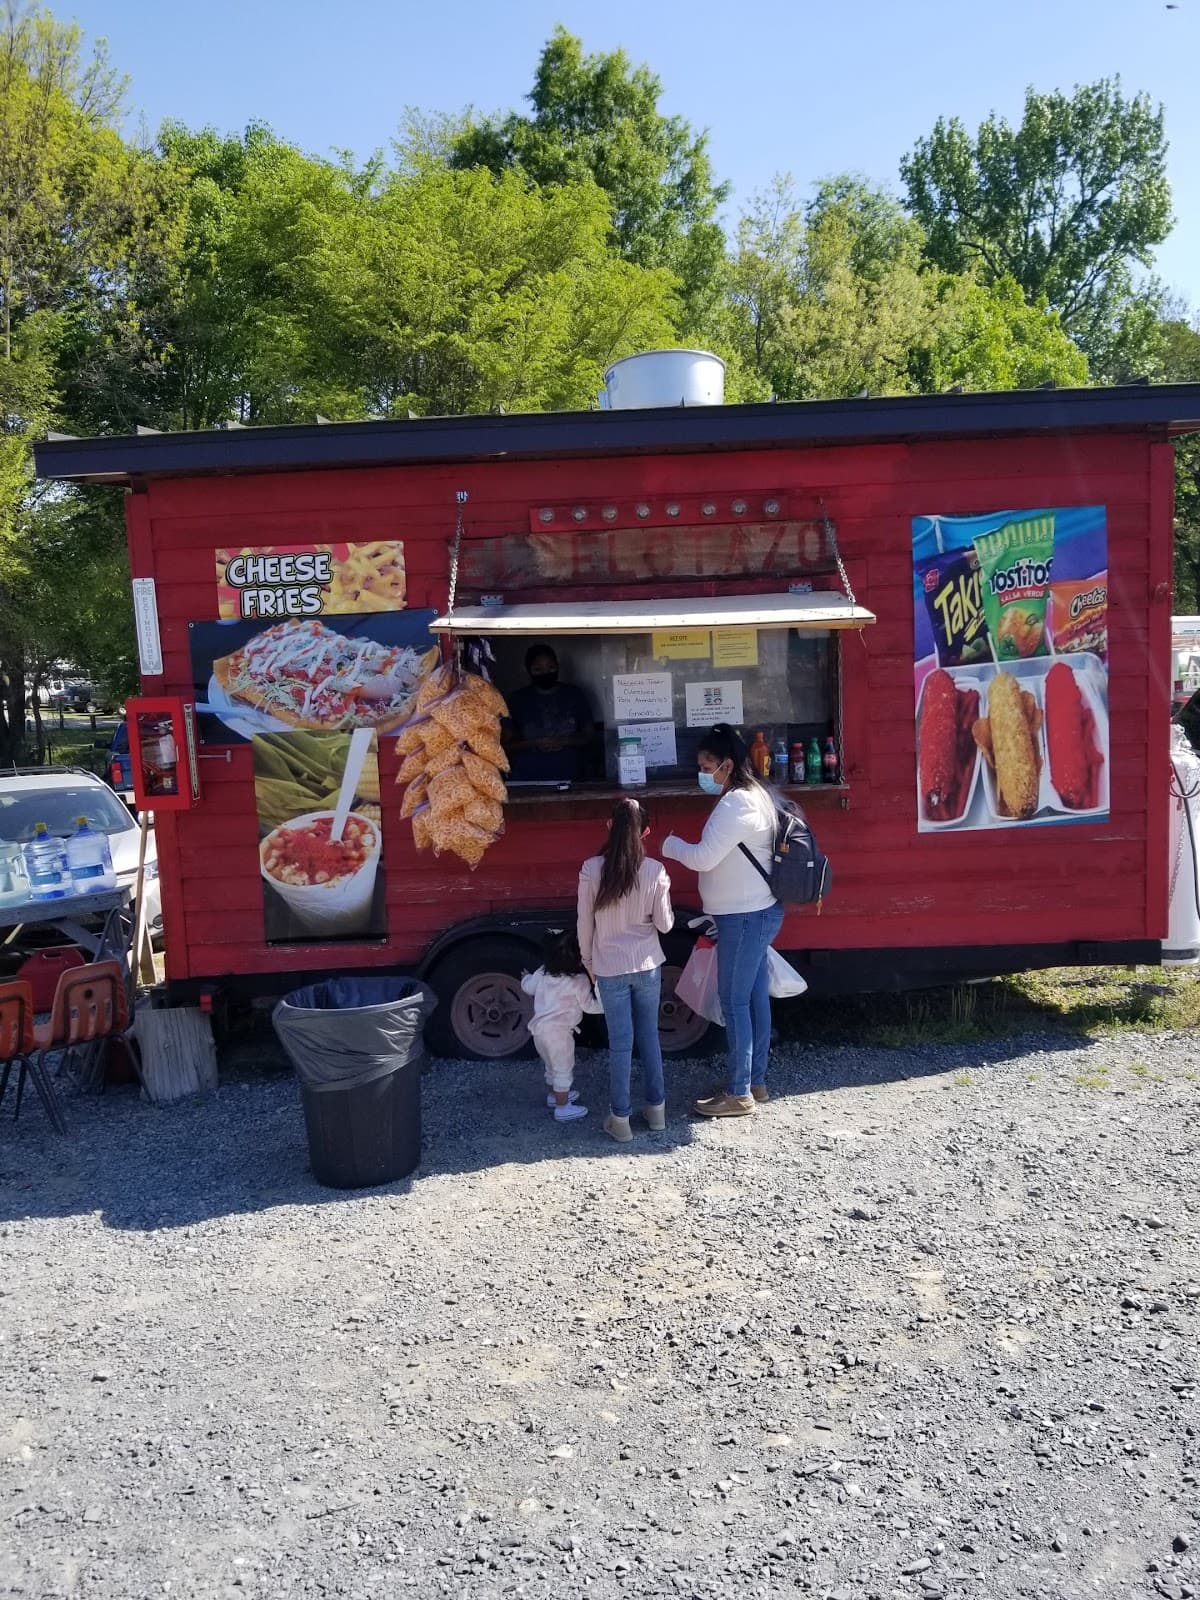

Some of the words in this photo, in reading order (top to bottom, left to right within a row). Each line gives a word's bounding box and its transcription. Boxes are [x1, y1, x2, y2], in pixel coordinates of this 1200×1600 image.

[571, 522, 826, 579] ELOTAZO
[226, 552, 333, 586] CHEESE
[136, 587, 152, 596] FIRE
[1001, 591, 1020, 604] SALSA
[1023, 590, 1044, 599] VERDE
[1069, 587, 1106, 619] Cheetos
[142, 597, 154, 666] EXTINGUISHER
